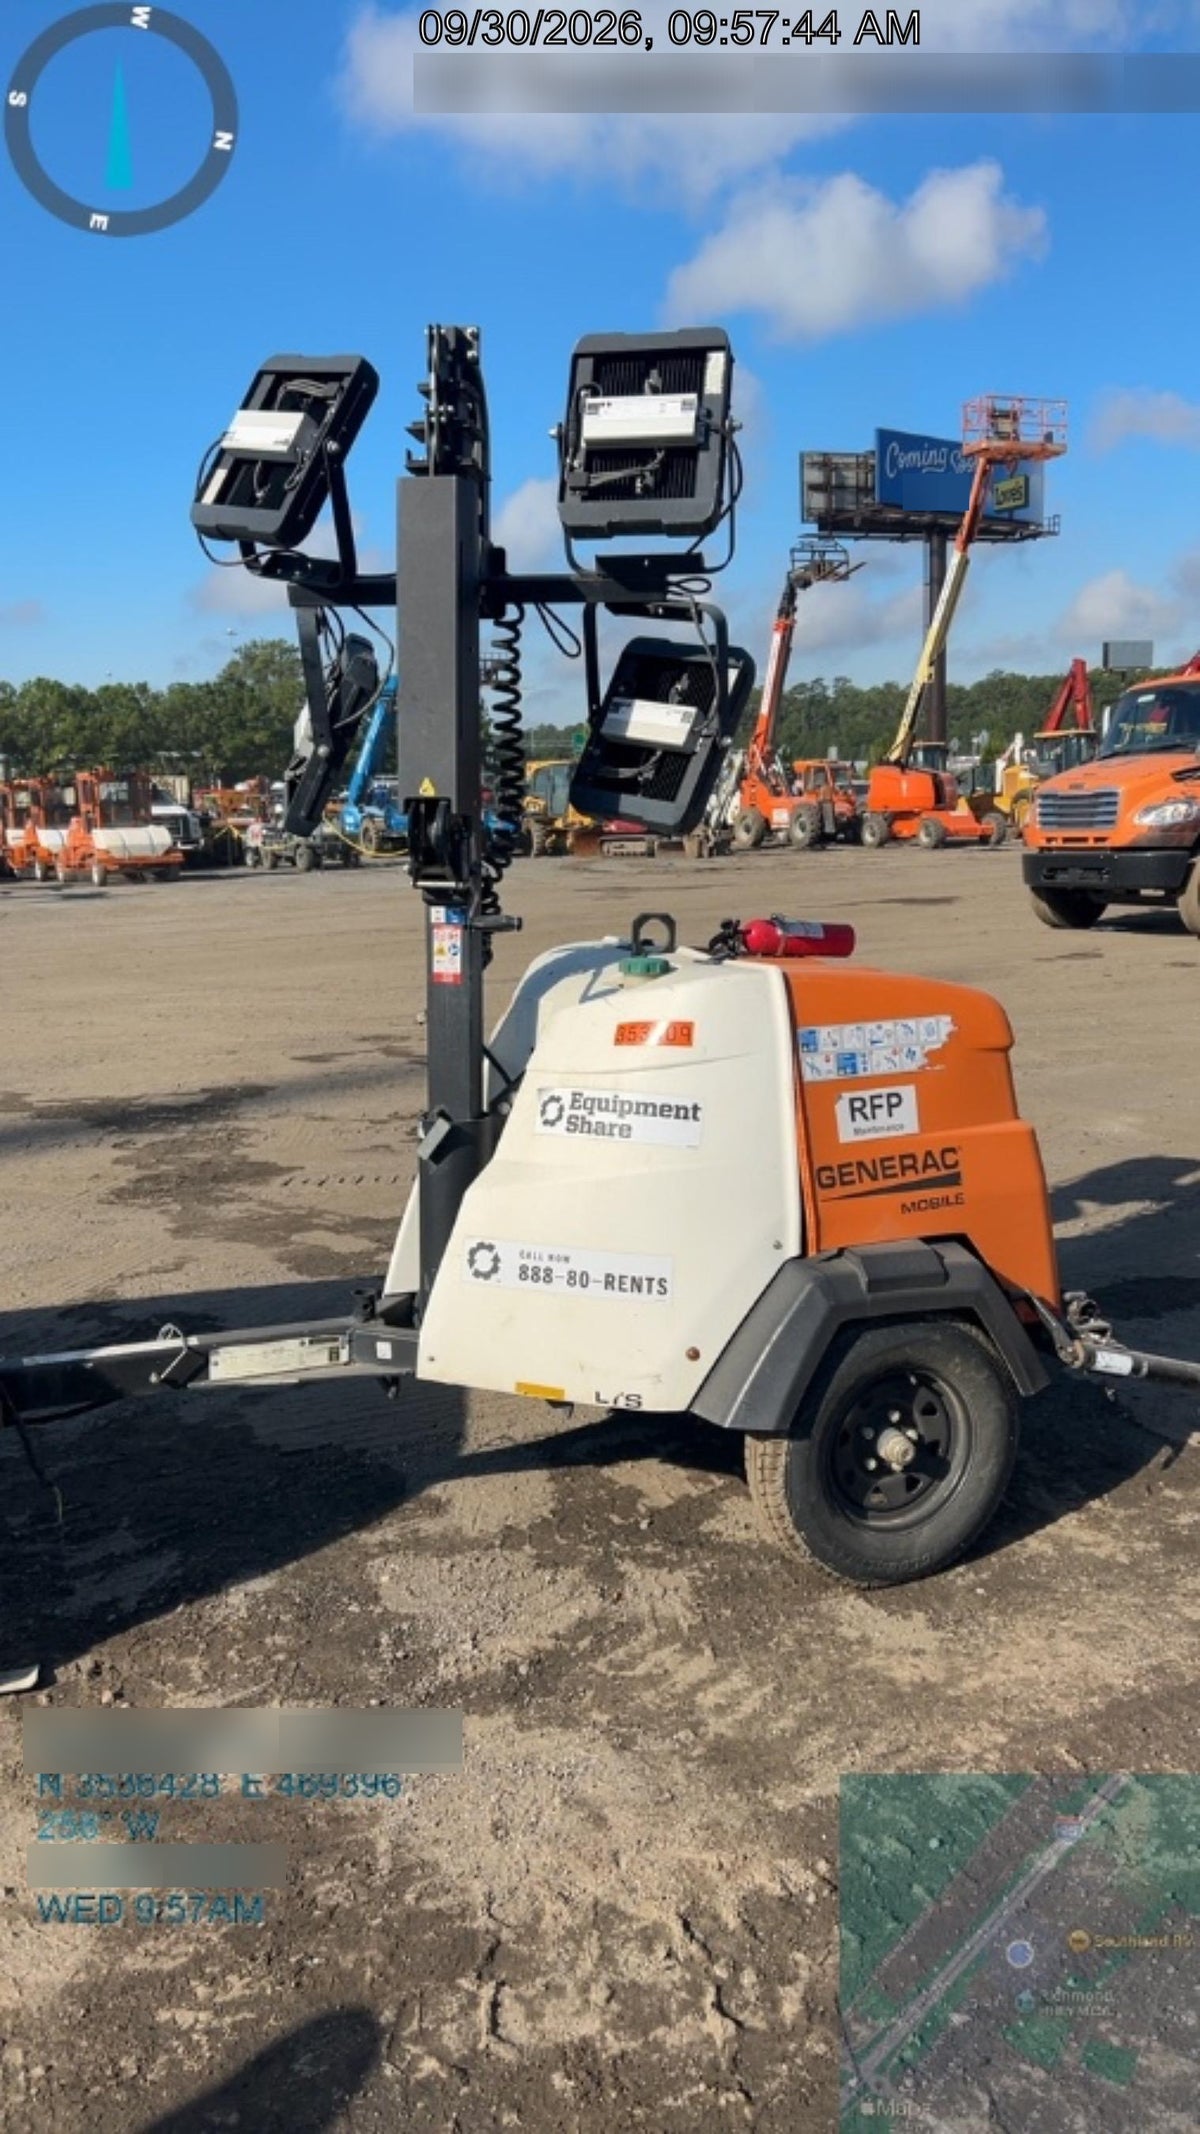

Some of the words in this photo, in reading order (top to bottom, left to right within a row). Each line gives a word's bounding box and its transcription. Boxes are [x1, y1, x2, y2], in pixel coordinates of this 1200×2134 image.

[886, 441, 948, 478] Coming
[568, 1091, 701, 1122] Equipment
[848, 1091, 903, 1123] RFP
[565, 1114, 632, 1139] Share
[814, 1146, 961, 1190] GENERAC
[901, 1192, 965, 1214] MOBILE
[517, 1263, 669, 1297] 888-80-RENTS
